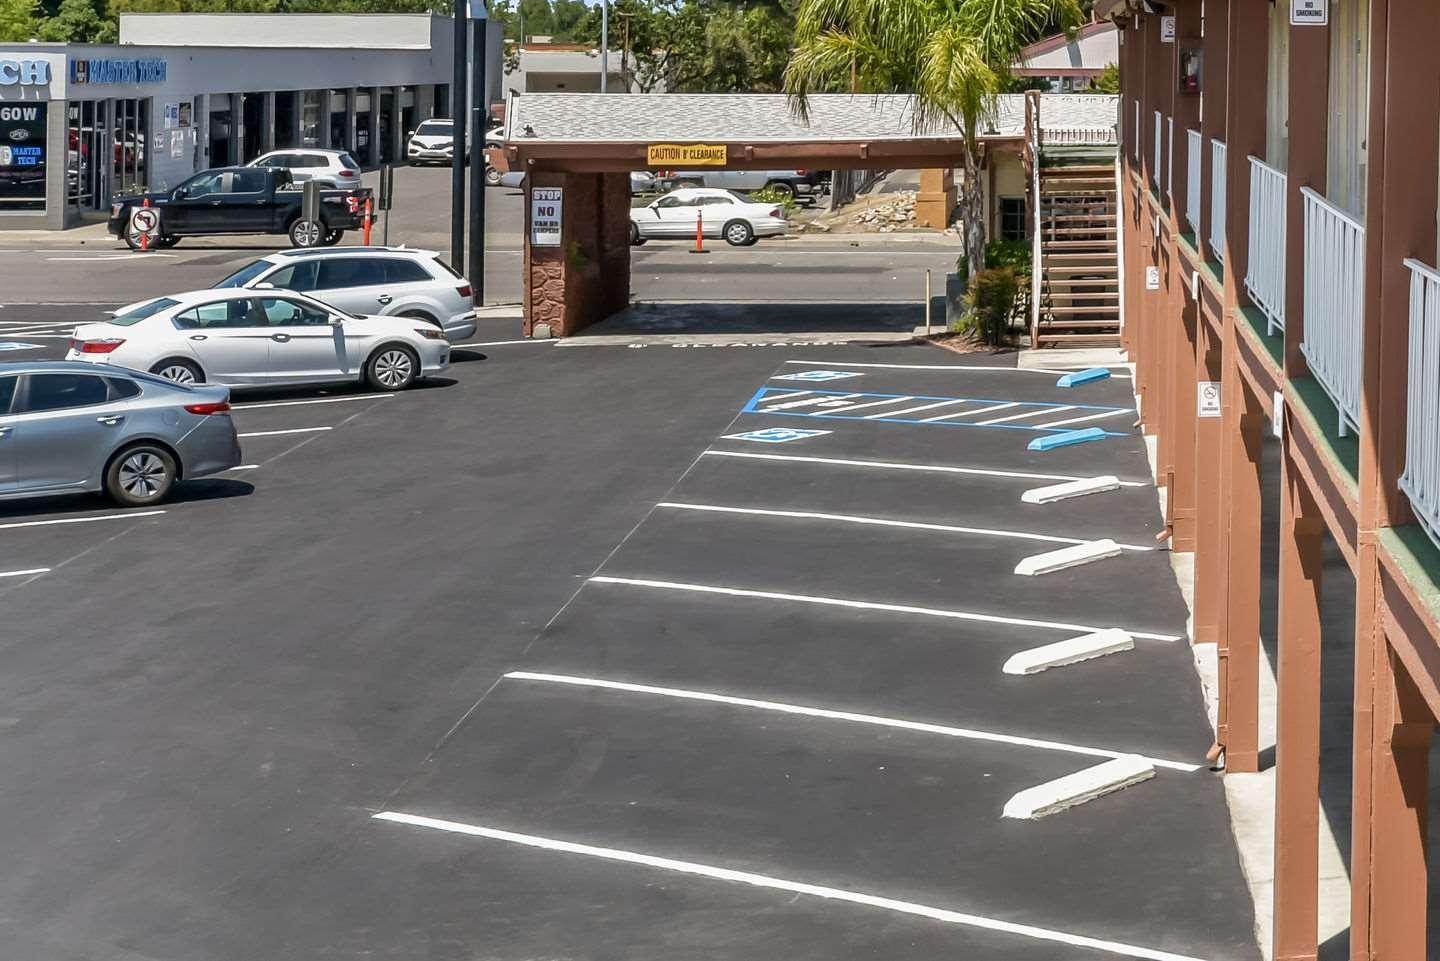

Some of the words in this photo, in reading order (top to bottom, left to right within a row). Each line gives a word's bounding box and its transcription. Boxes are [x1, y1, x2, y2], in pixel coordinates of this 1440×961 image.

[90, 59, 137, 83] MASTER
[138, 59, 168, 83] TECH
[13, 147, 41, 155] MASTER
[650, 148, 680, 160] CAUTION
[689, 149, 724, 160] CLEARANCE
[18, 157, 36, 165] TECH
[534, 191, 560, 200] STOP
[538, 207, 554, 216] NO
